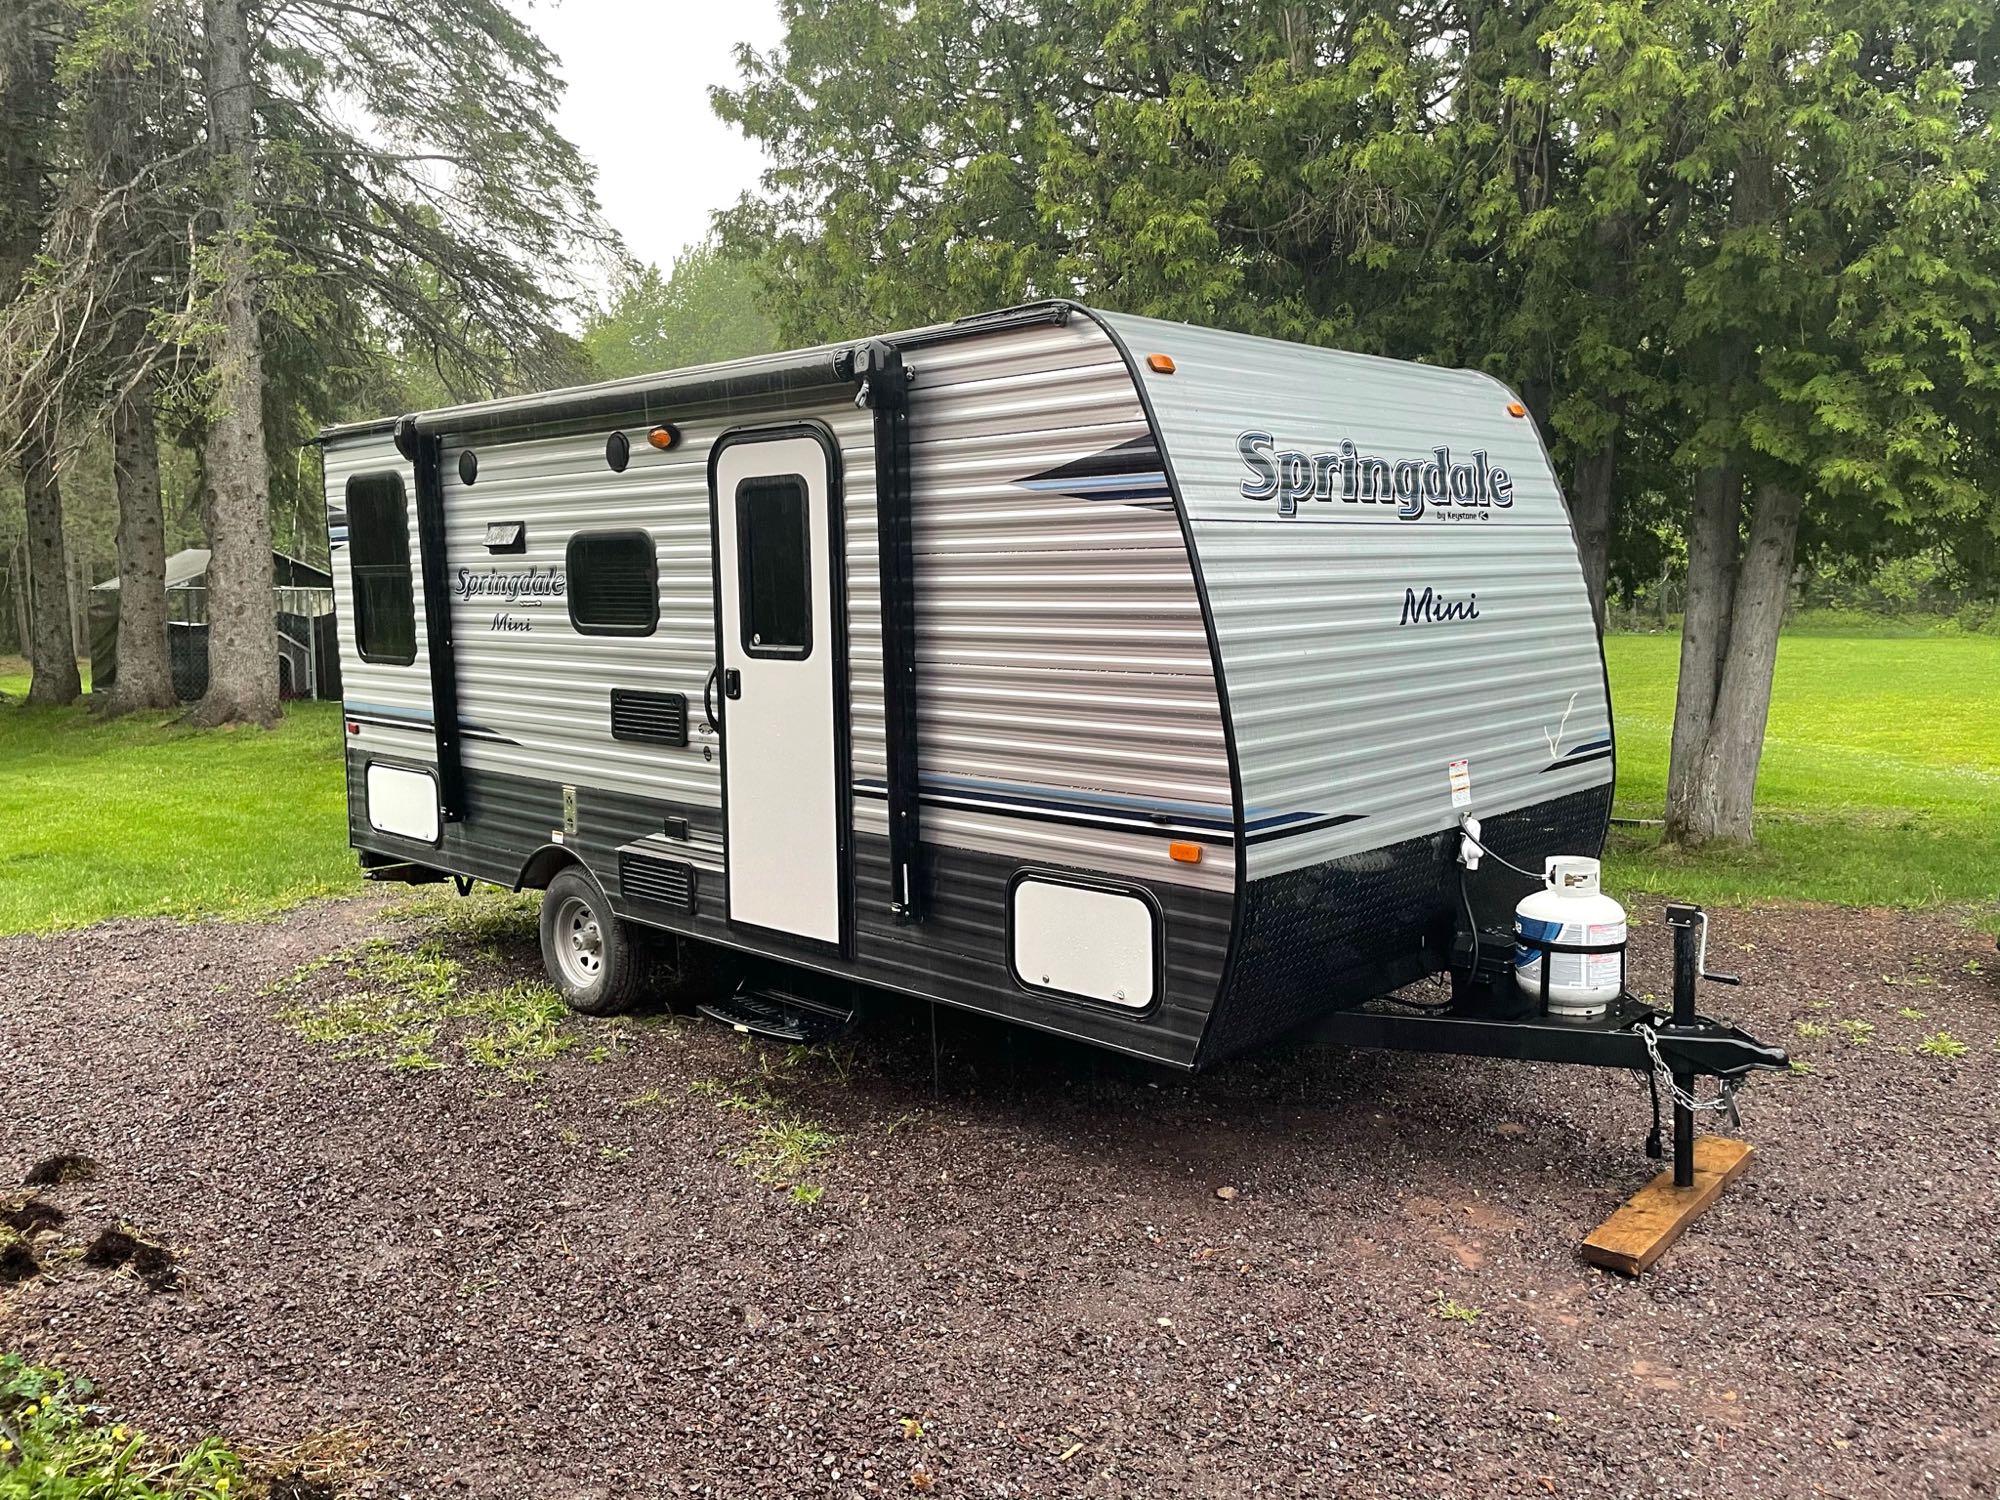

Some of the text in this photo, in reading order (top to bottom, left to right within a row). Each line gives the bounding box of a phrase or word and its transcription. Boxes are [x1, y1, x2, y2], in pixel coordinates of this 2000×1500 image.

[1236, 430, 1513, 520] Springdale
[1436, 511, 1477, 521] by Keystone
[456, 565, 565, 602] Springdale
[491, 613, 532, 631] Mini
[1400, 586, 1480, 626] Mini
